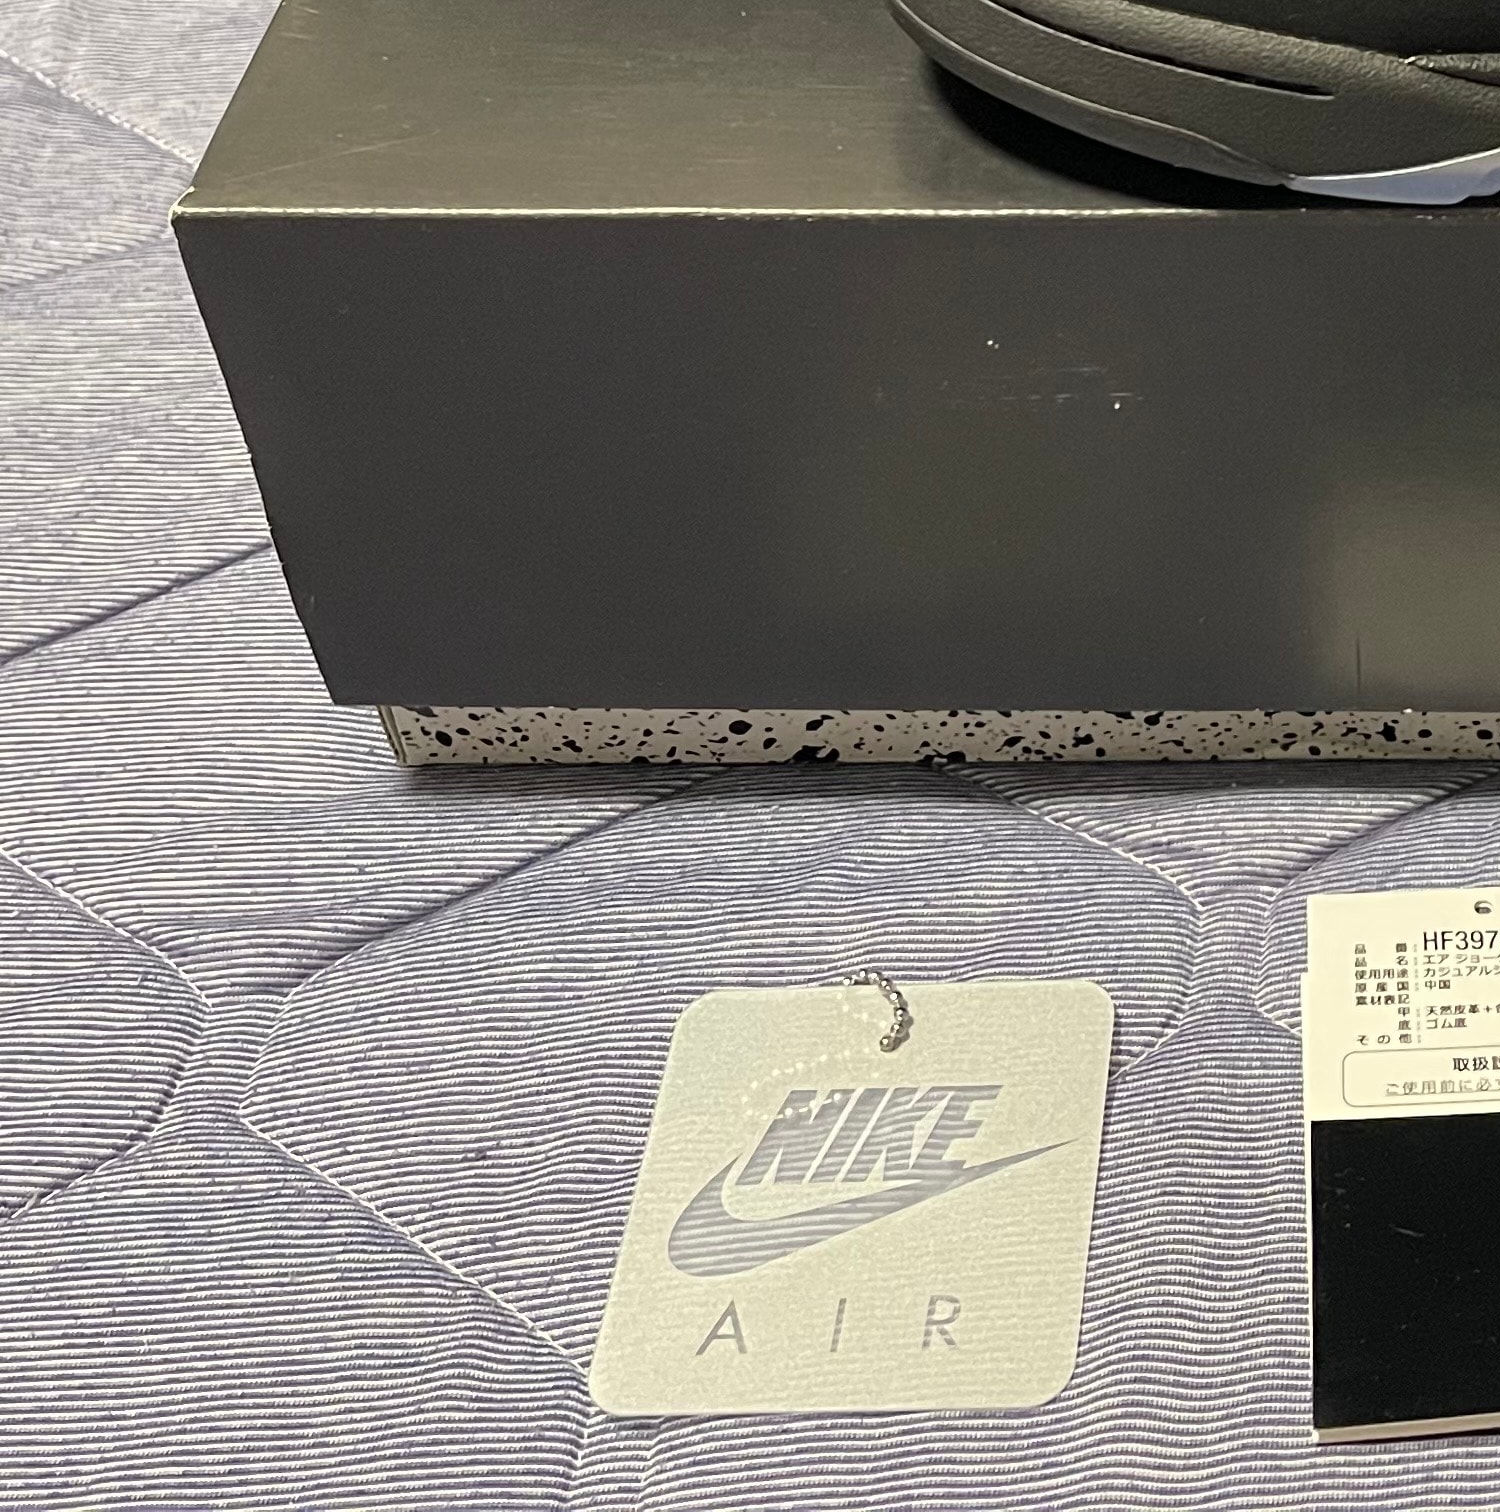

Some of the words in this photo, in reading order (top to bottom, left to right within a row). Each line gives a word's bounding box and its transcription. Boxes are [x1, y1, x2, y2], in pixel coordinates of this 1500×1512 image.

[1424, 980, 1451, 990] 中国
[1426, 1017, 1468, 1030] ゴム底
[734, 1084, 1004, 1187] NIKE
[695, 1294, 963, 1357] AIR
